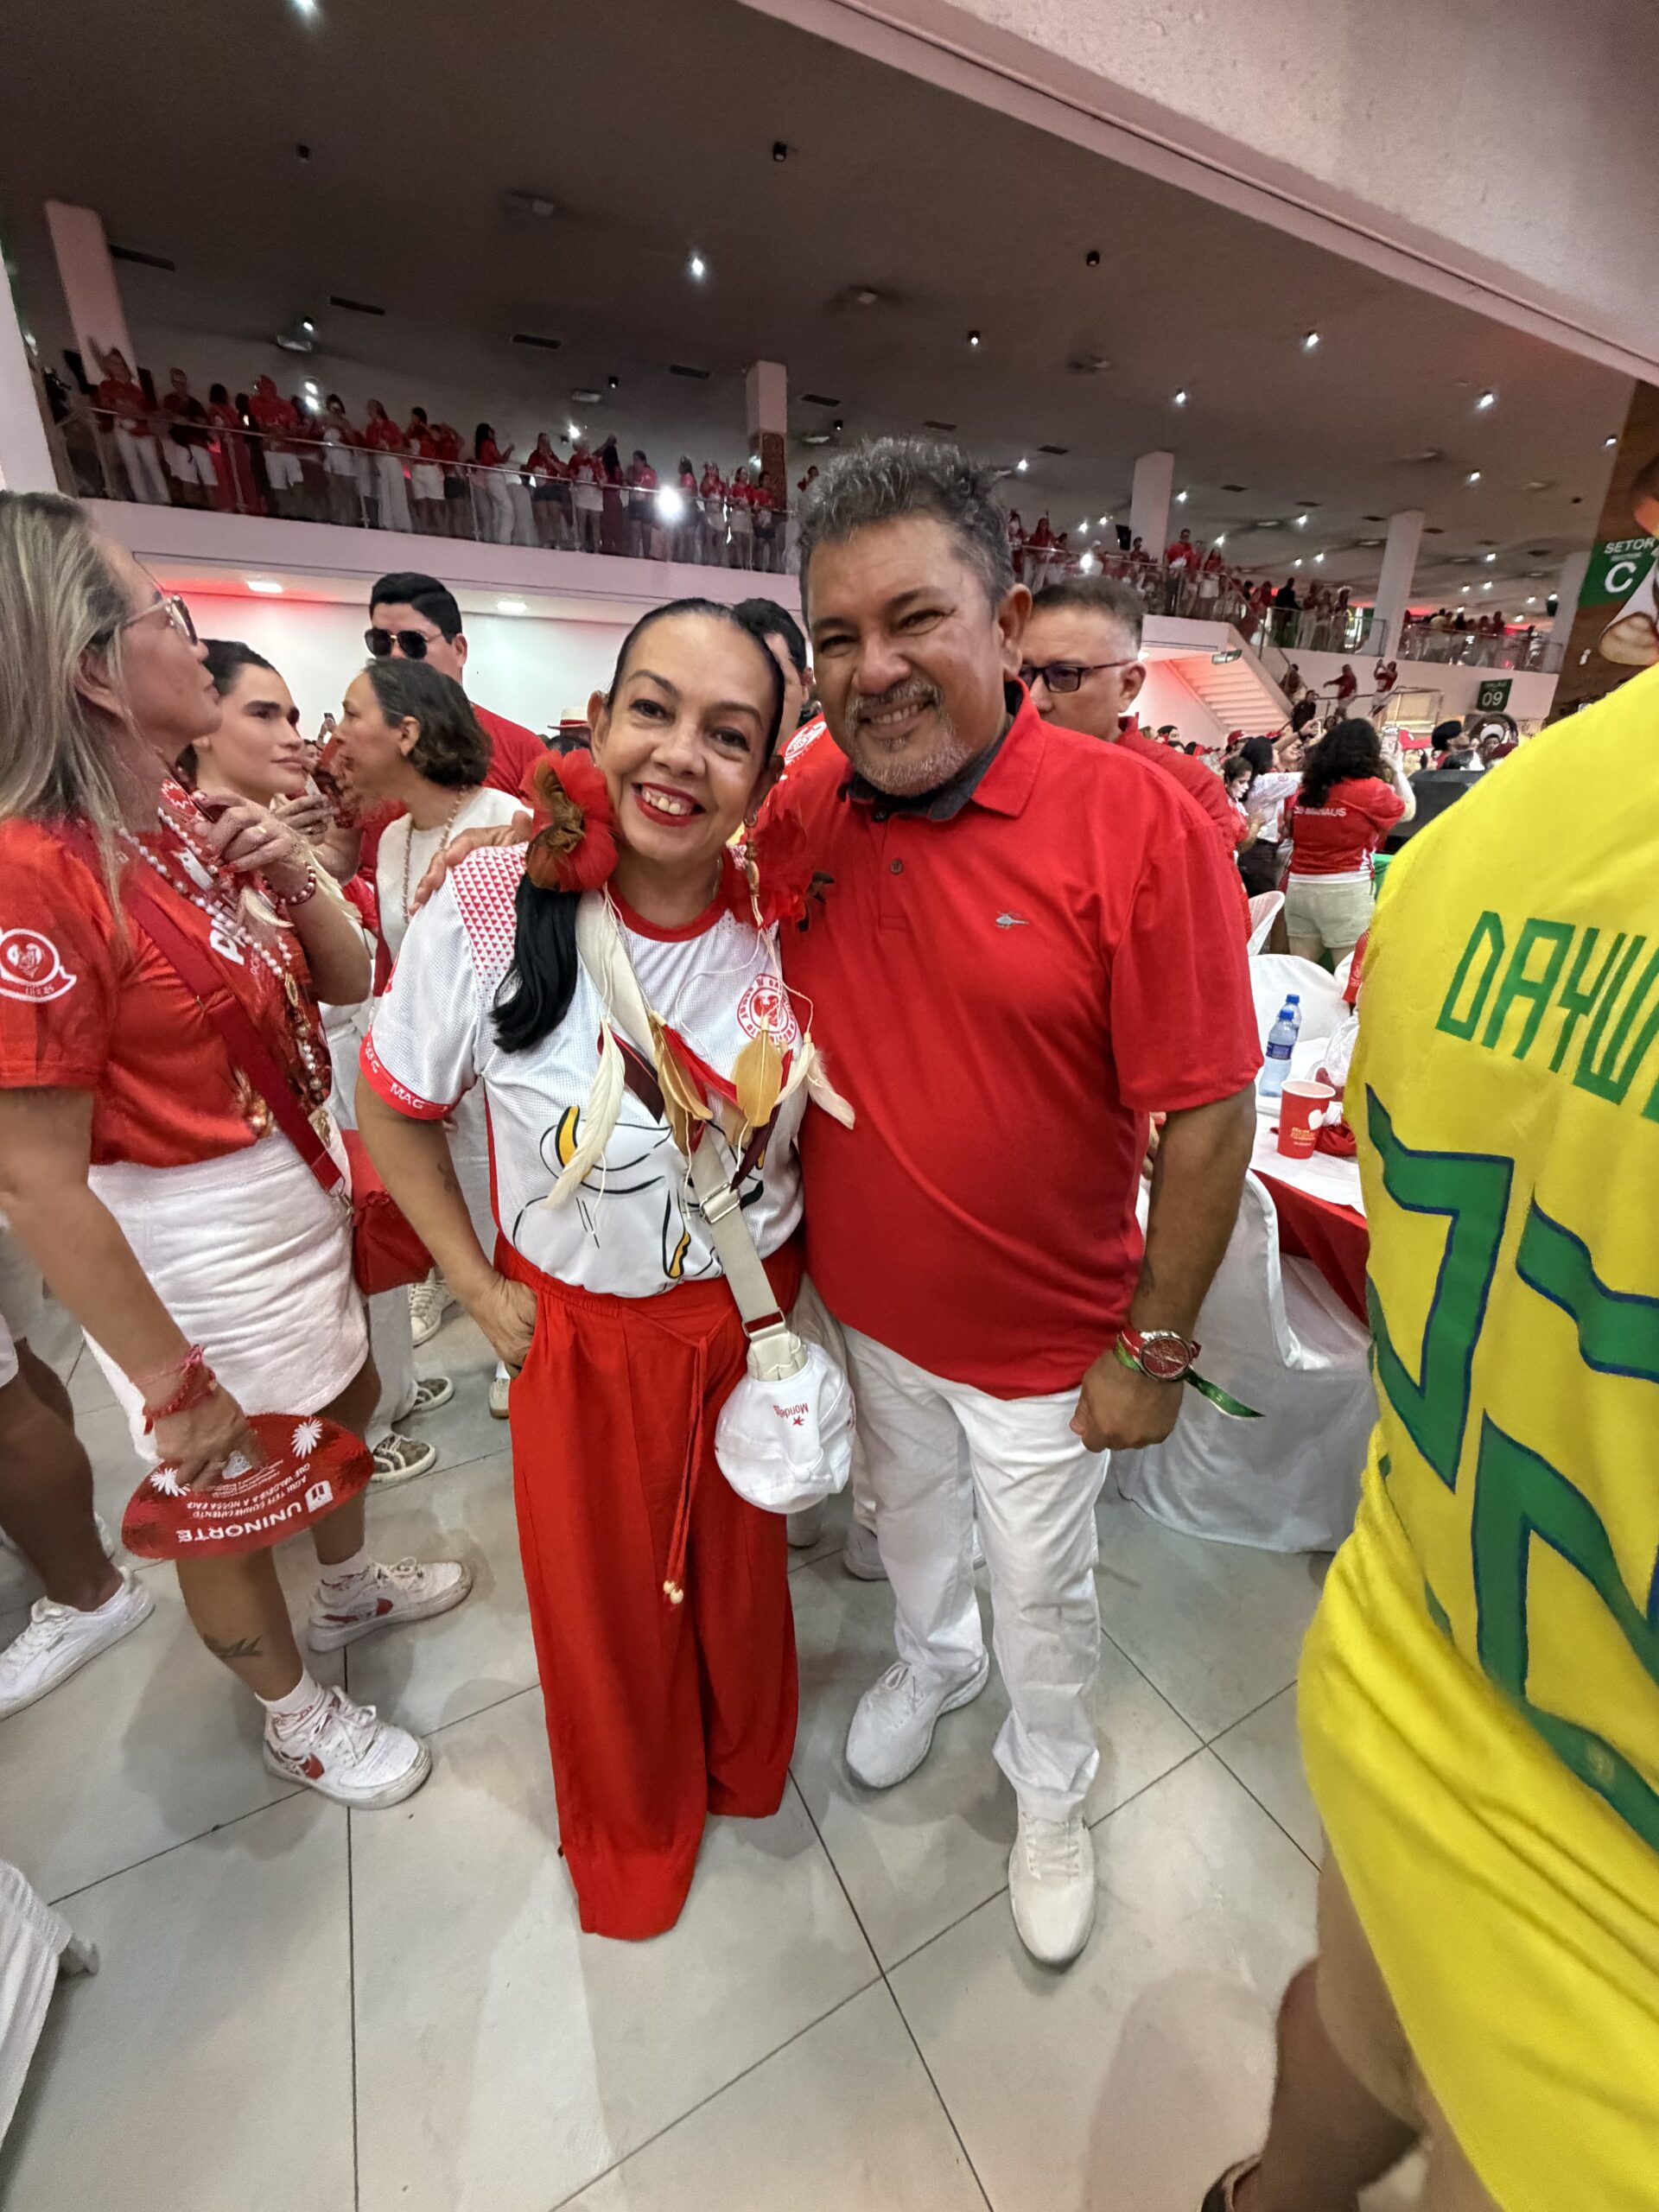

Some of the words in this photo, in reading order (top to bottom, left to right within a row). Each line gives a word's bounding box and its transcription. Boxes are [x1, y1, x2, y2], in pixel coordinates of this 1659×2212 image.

[1605, 537, 1655, 554] SETOR
[1605, 561, 1637, 594] C
[1482, 691, 1503, 706] 09
[1435, 910, 1659, 1124] DAYW
[175, 1502, 302, 1543] UNINORTE
